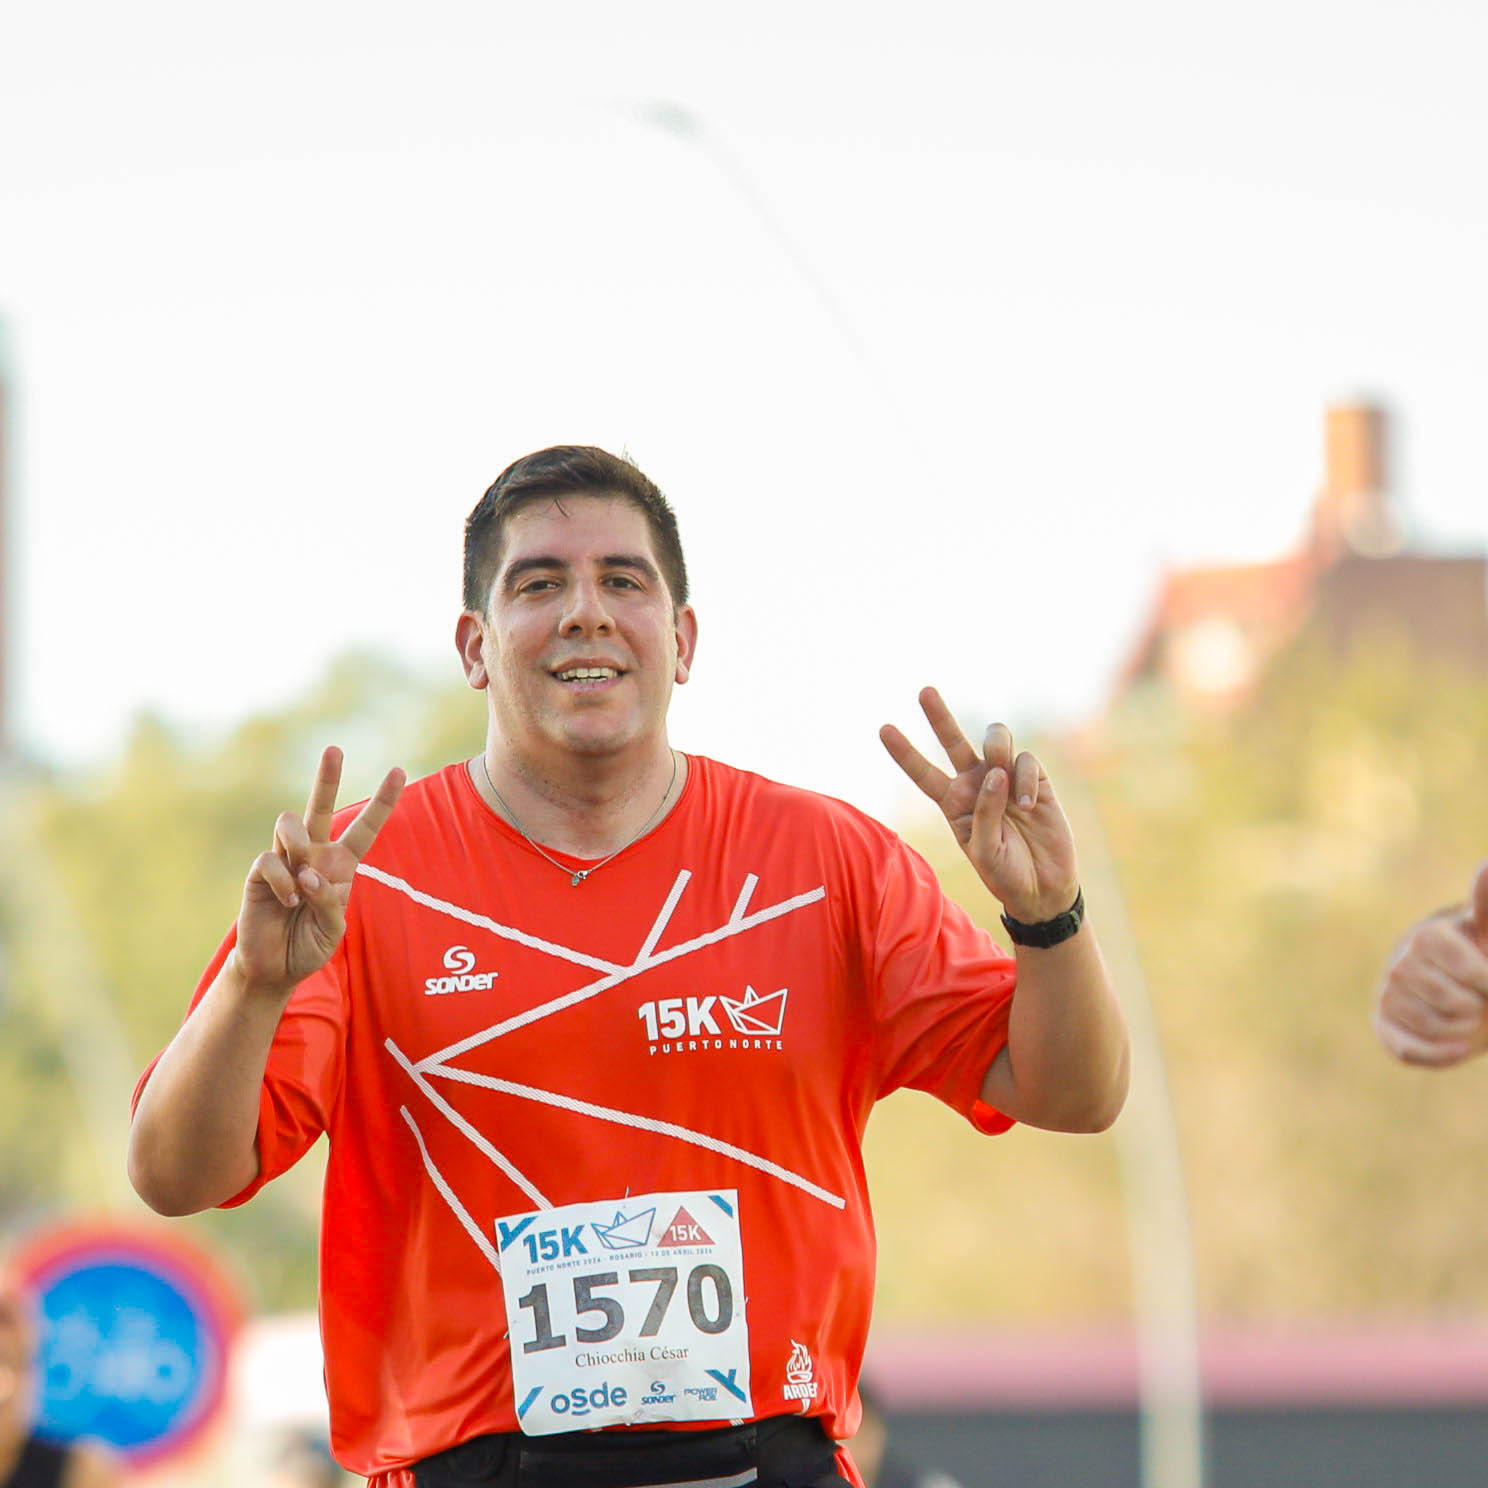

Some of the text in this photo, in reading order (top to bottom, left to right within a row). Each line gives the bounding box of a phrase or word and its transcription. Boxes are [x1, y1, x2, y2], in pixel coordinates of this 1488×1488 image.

[638, 996, 721, 1041] 15K
[649, 1039, 783, 1056] PUERTO NORTE
[523, 1224, 588, 1264] 15K
[669, 1224, 703, 1242] 15K
[518, 1264, 735, 1354] 1570
[575, 1347, 689, 1368] Chiocchia César
[550, 1381, 627, 1416] osde
